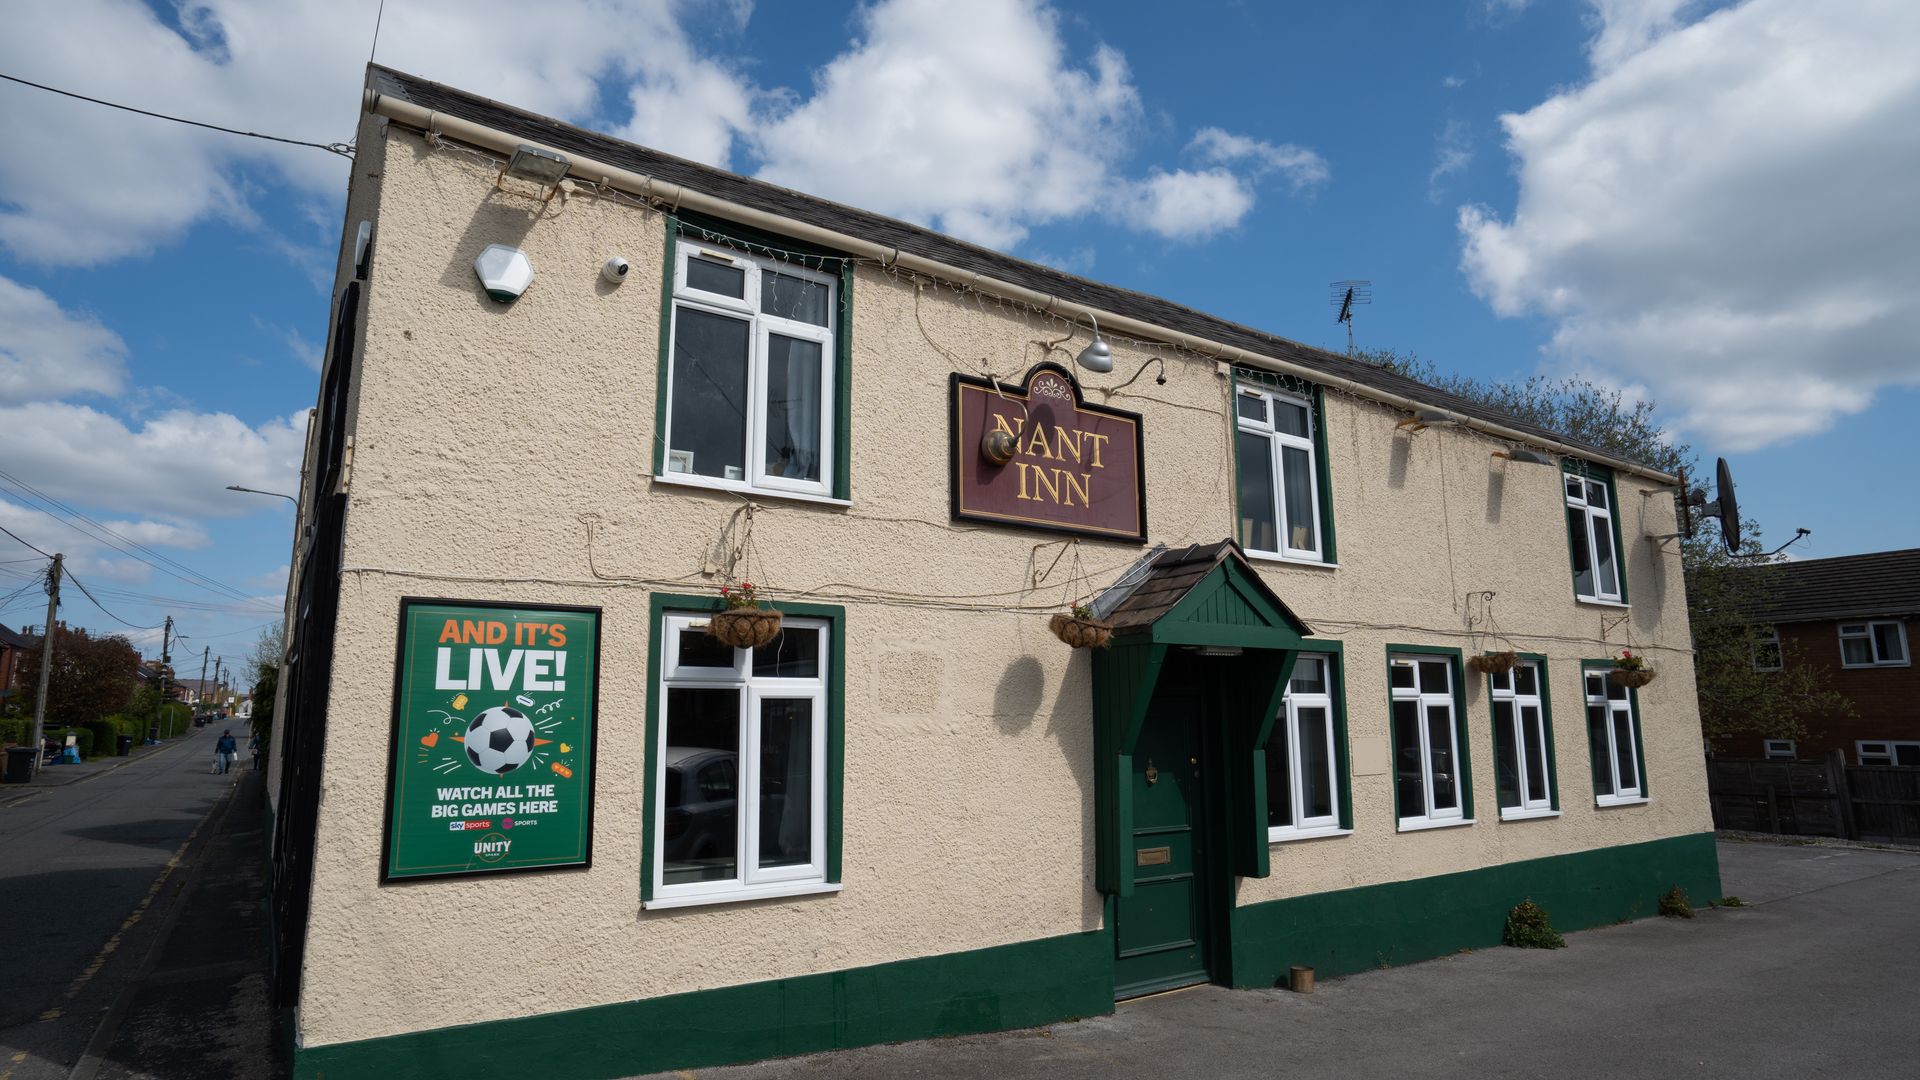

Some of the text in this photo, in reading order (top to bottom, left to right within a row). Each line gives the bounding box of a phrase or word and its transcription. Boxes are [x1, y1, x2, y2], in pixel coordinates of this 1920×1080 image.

[1015, 462, 1091, 508] INN
[438, 619, 567, 647] AND IT'S
[435, 647, 567, 692] LIVE!
[436, 784, 555, 801] WATCH ALL THE
[431, 800, 558, 818] BIG GAMES HERE
[473, 840, 512, 854] UNITY
